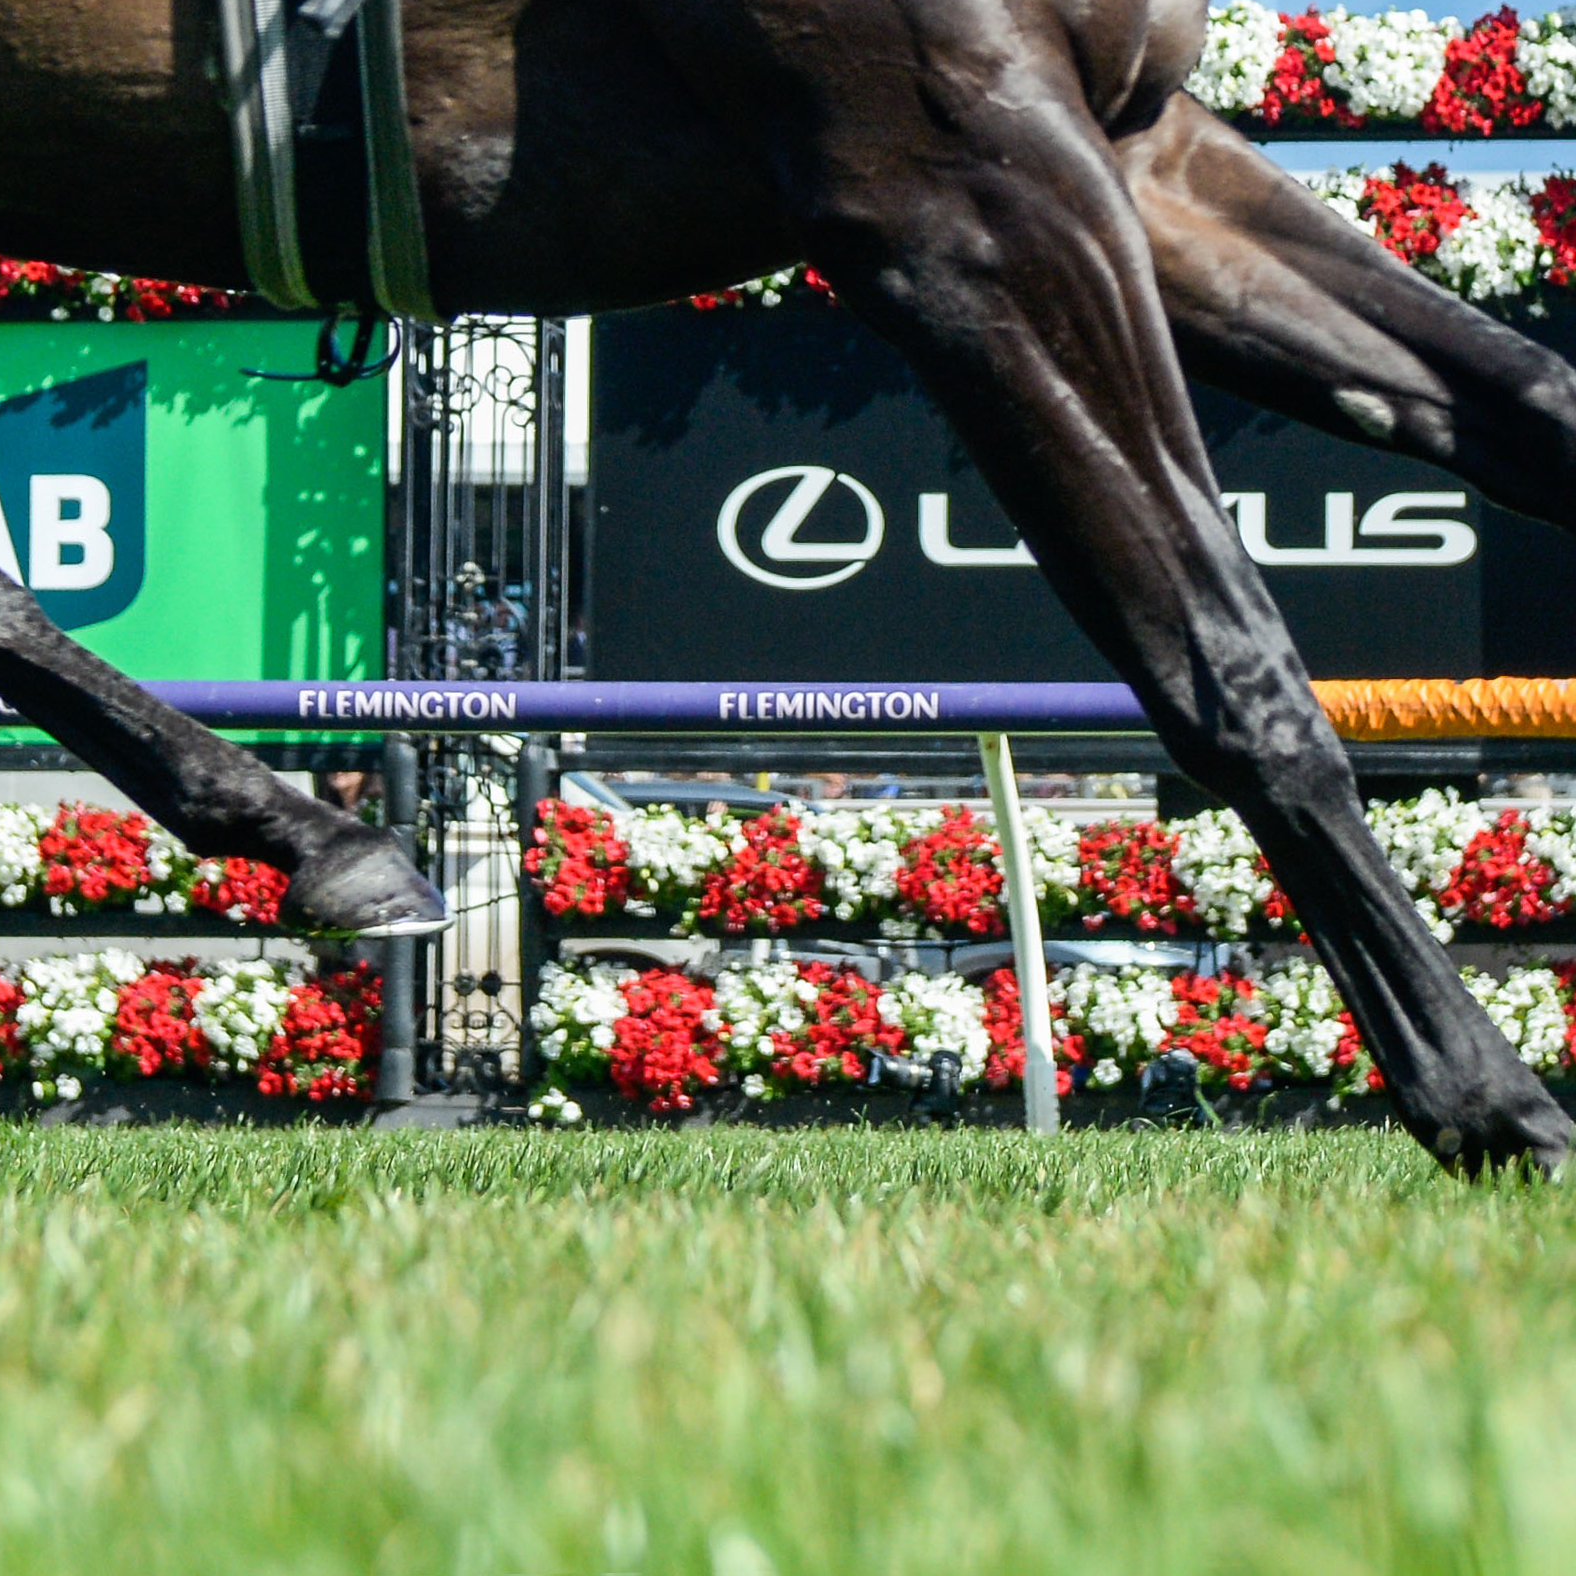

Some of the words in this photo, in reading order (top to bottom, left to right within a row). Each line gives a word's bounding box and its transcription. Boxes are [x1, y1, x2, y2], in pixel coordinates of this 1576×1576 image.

[918, 491, 1478, 567] LUS
[298, 689, 517, 721] FLEMINGTON
[719, 690, 939, 721] FLEMINGTON
